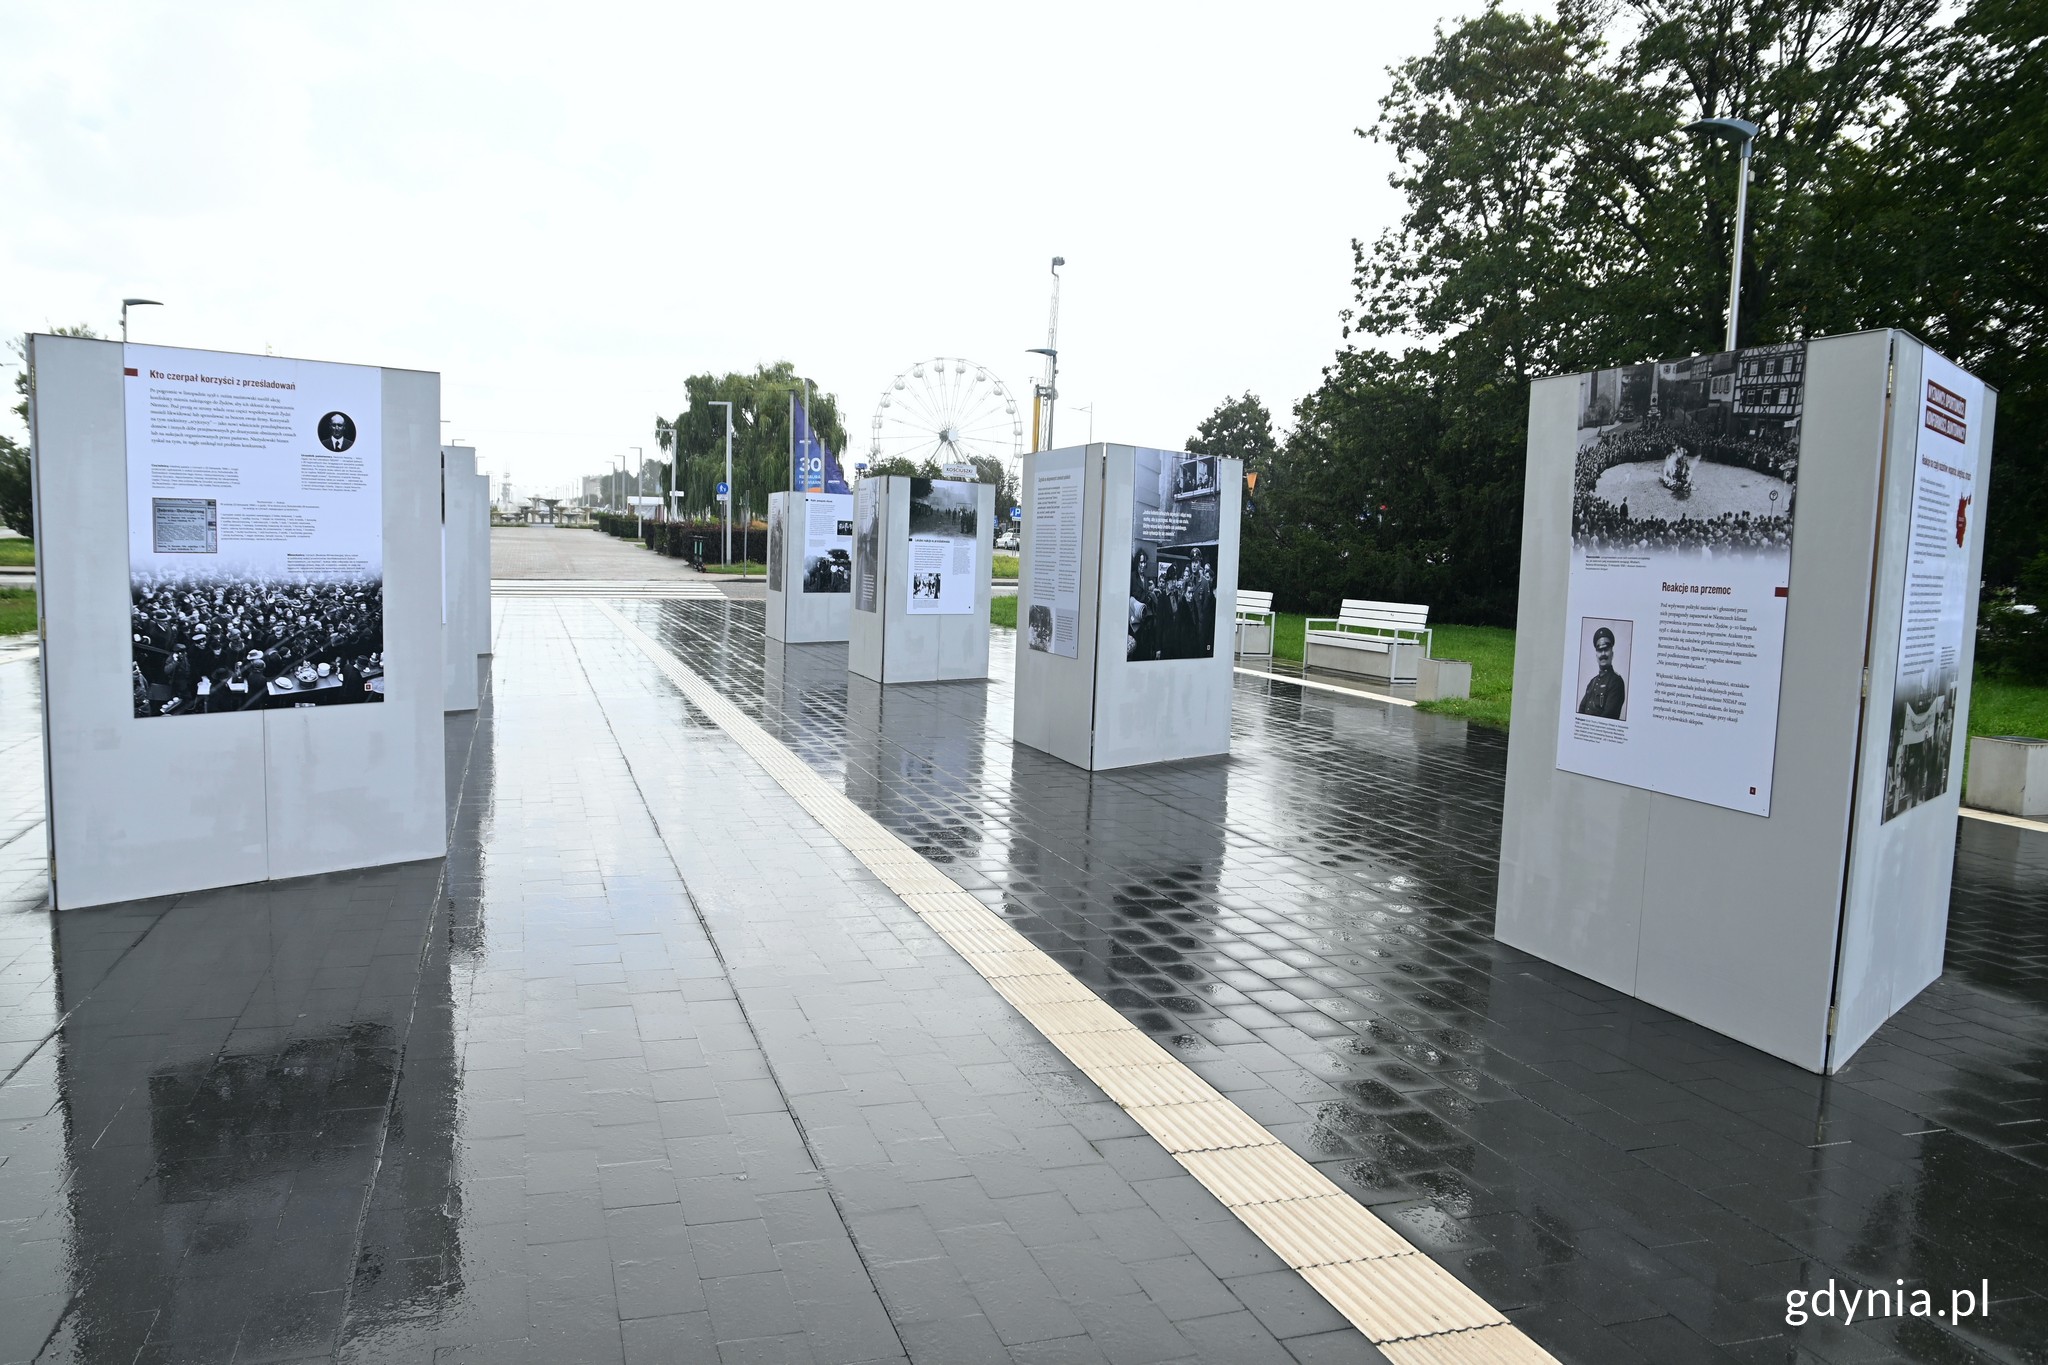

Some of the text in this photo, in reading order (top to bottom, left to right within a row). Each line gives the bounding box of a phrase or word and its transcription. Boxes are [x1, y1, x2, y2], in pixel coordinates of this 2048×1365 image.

[149, 370, 164, 379] Kto
[167, 373, 198, 382] czerpał
[201, 374, 234, 385] korzyści
[243, 379, 296, 390] prześladowań
[799, 457, 822, 472] 30
[1662, 582, 1731, 595] Reakcje na przemoc
